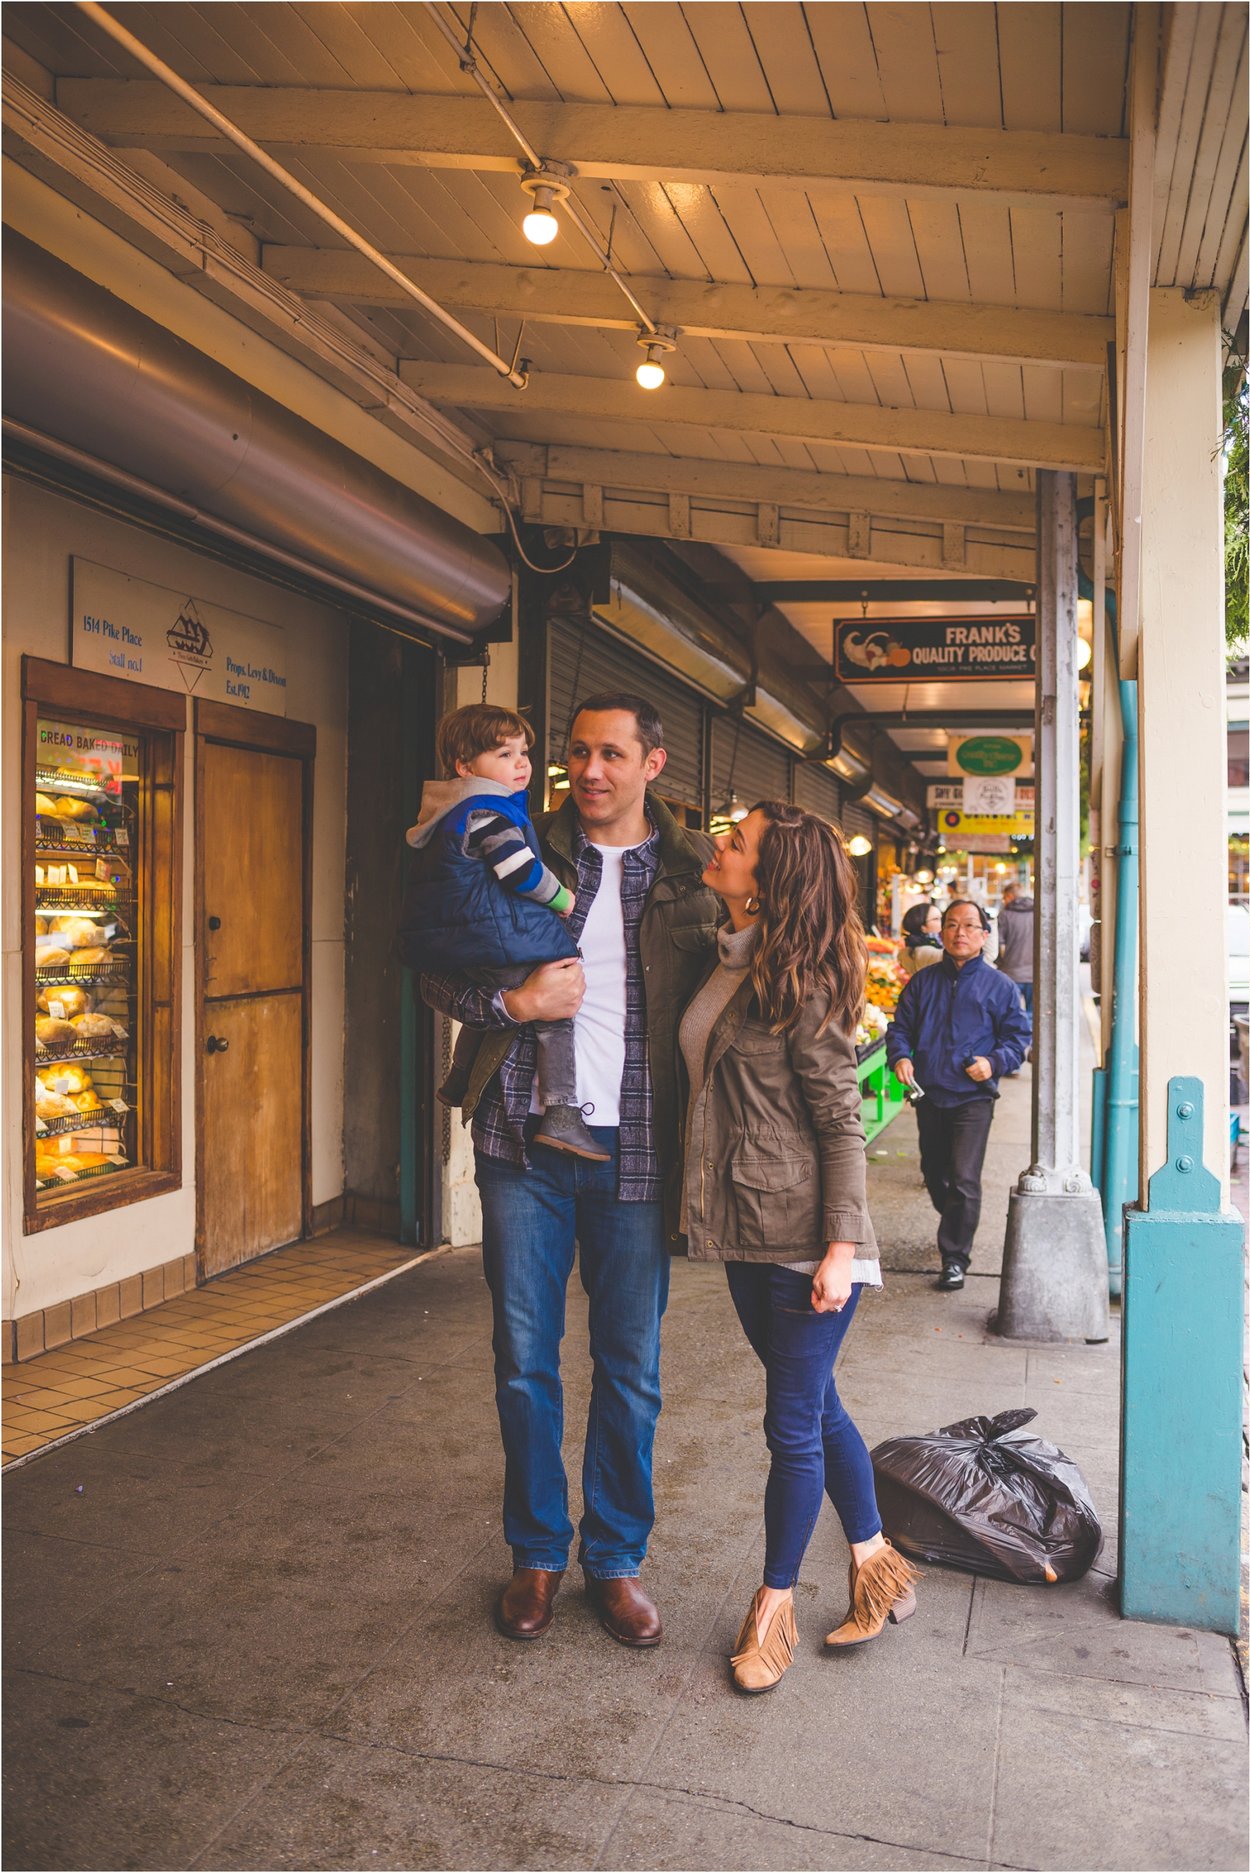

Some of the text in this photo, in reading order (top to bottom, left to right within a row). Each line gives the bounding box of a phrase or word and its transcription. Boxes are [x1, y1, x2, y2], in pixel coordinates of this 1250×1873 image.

[83, 615, 142, 647] 1514 Pike Place
[945, 622, 1021, 645] FRANK'S
[912, 646, 965, 664] QUALITY
[969, 644, 1027, 663] PRODUCE
[40, 730, 139, 758] BREAD BAKED DAILY
